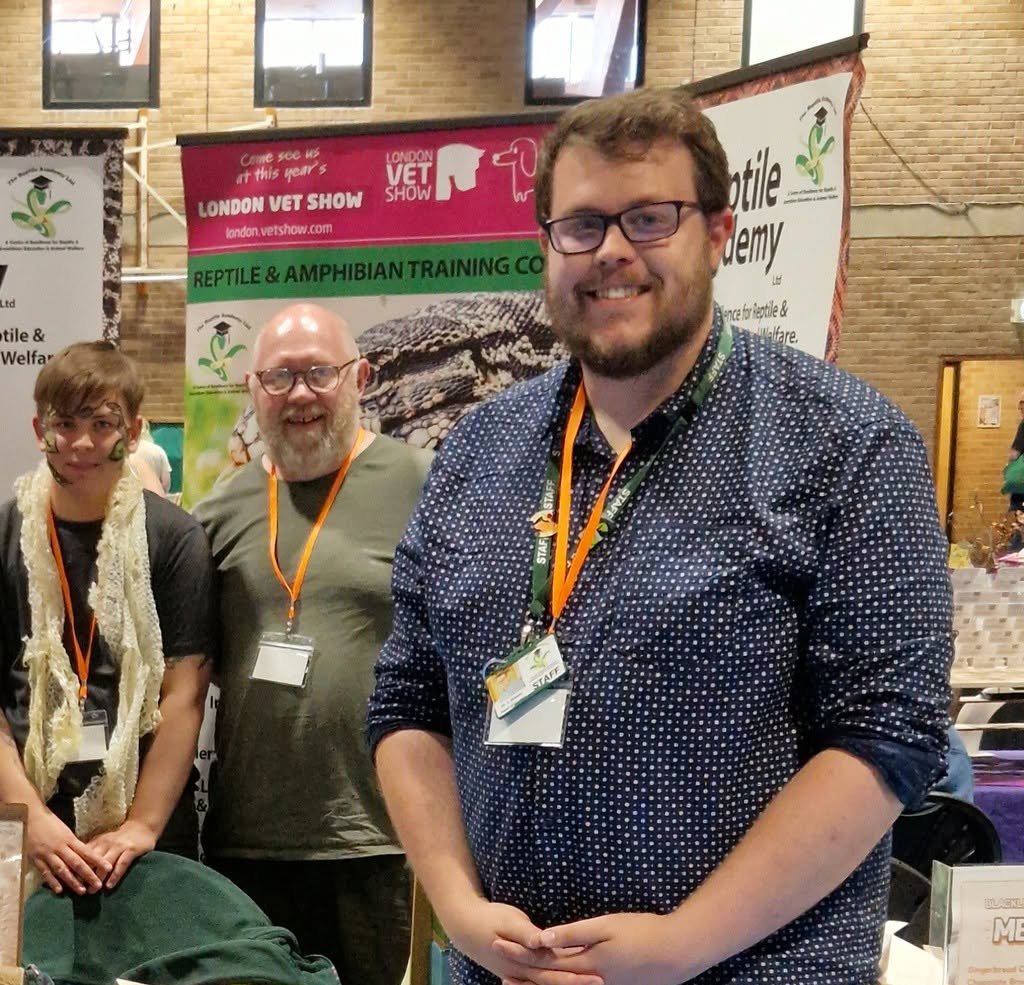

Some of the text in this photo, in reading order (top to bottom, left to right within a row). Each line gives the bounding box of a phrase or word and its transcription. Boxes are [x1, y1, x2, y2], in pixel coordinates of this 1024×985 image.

[240, 147, 320, 167] Come see us
[386, 150, 433, 163] LONDON
[236, 161, 327, 185] at this year's
[386, 162, 433, 185] VET
[729, 146, 781, 212] ptile
[198, 191, 363, 218] LONDON VET SHOW
[385, 185, 432, 202] SHOW
[722, 214, 784, 276] demy
[193, 266, 261, 288] REPTILE
[265, 265, 281, 283] &
[284, 260, 404, 284] AMPHIBIAN
[408, 256, 510, 278] TRAINING
[0, 298, 16, 309] Ltd
[780, 300, 788, 317] &
[33, 328, 45, 342] &
[1, 351, 53, 366] Welfar
[543, 479, 555, 509] STAFF
[606, 489, 631, 519] STAFF
[537, 539, 548, 564] STAF
[532, 666, 561, 689] STAFF
[992, 916, 1024, 945] ME
